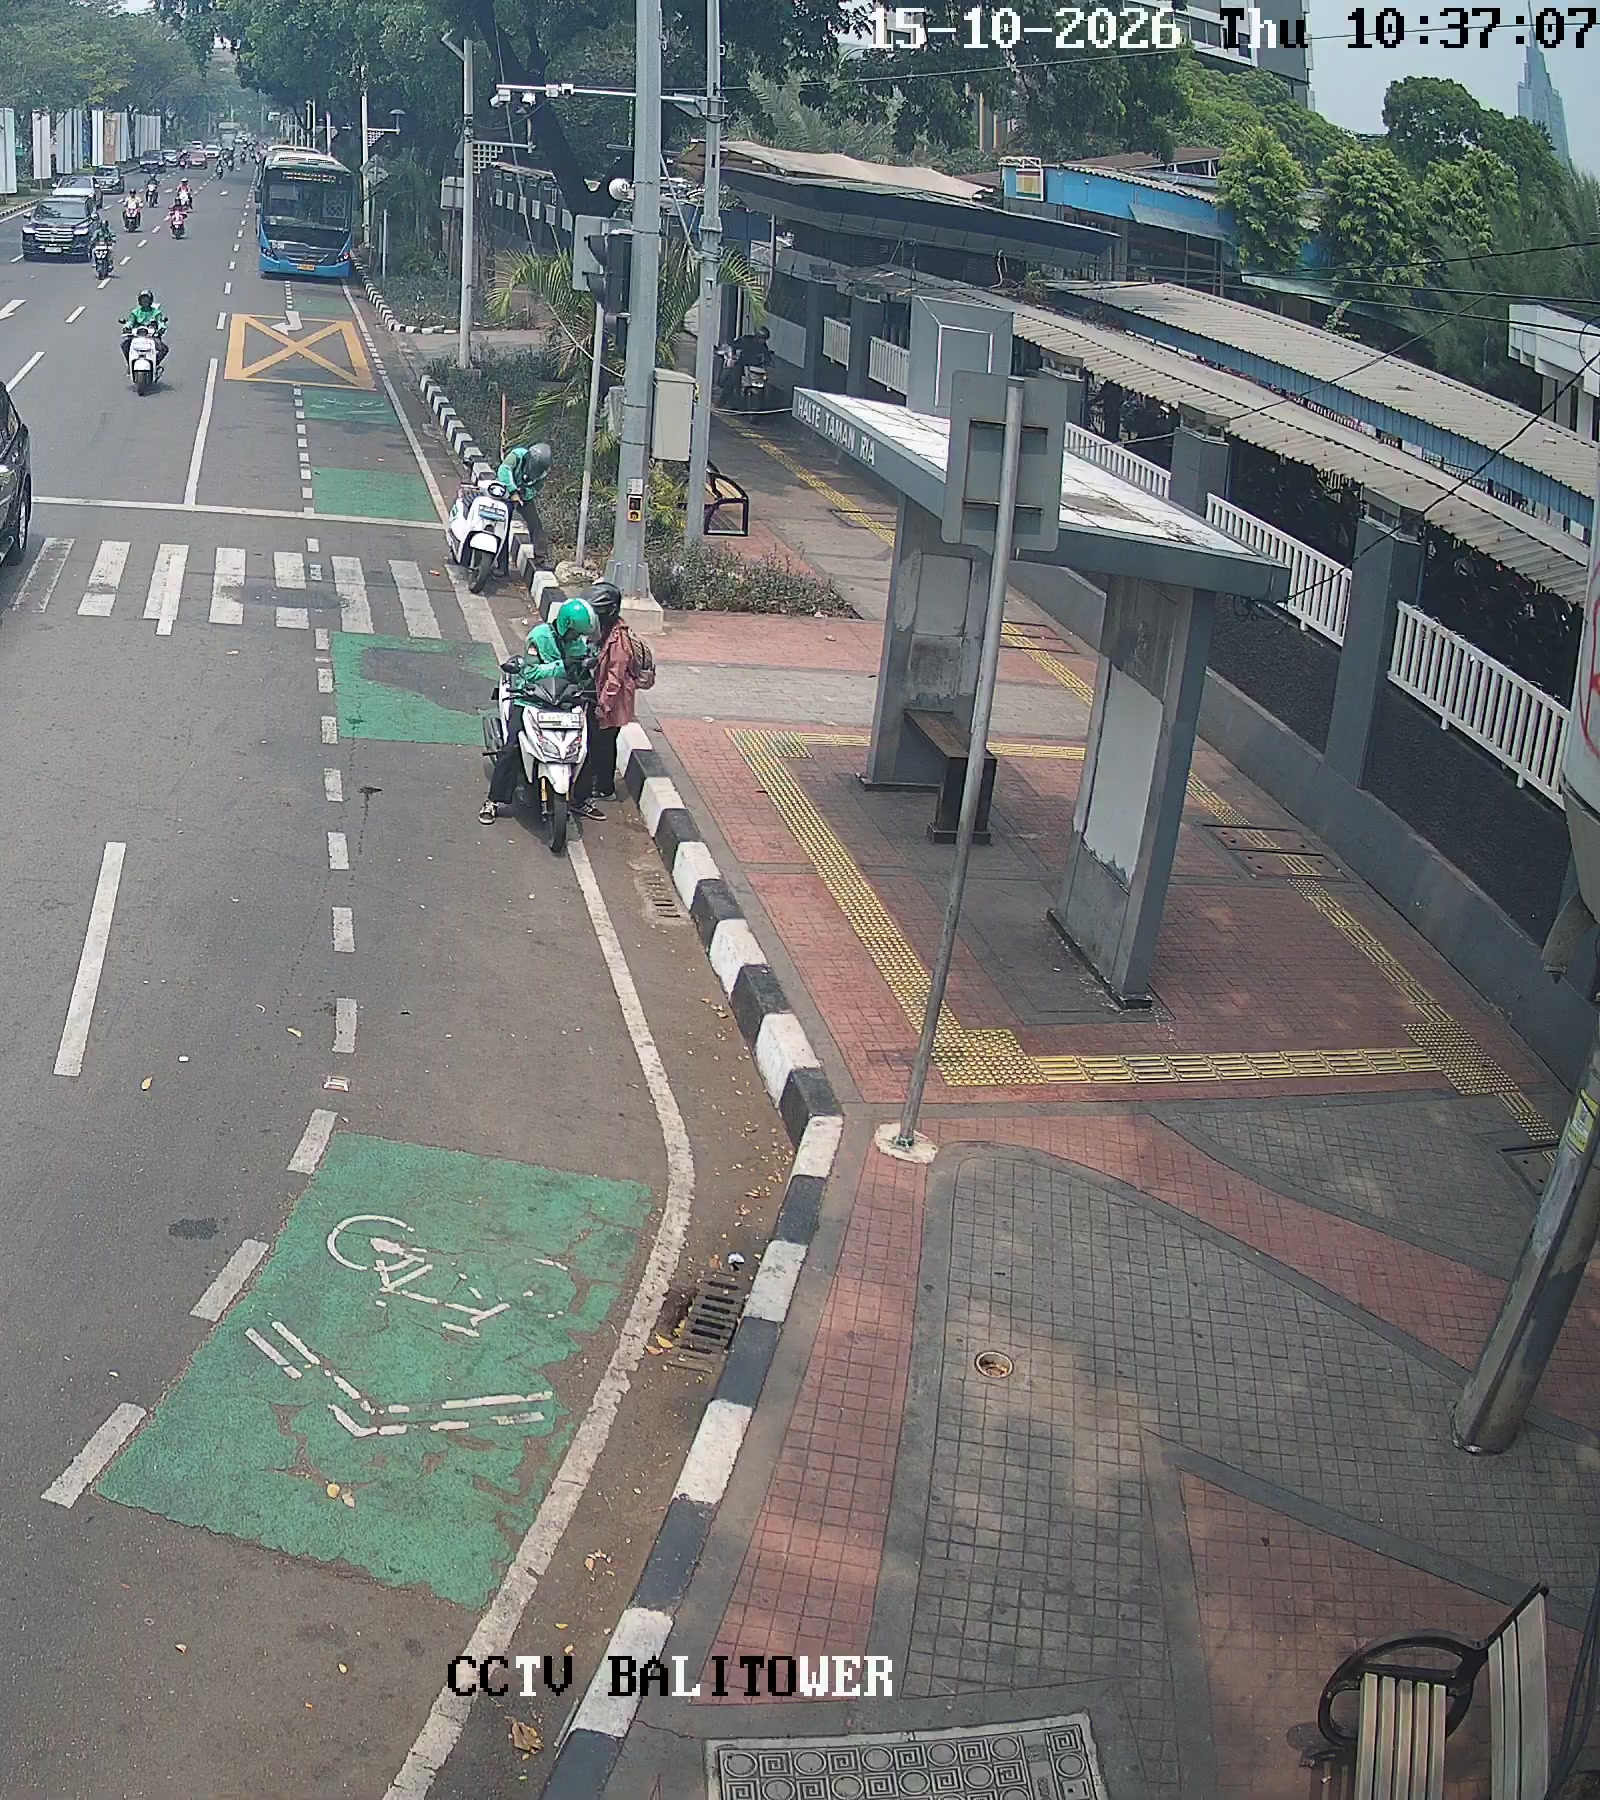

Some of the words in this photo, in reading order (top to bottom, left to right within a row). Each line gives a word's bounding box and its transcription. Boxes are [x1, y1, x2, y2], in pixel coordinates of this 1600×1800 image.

[797, 395, 821, 428] HALTE
[825, 411, 856, 452] TAMAN
[860, 436, 875, 466] RIA
